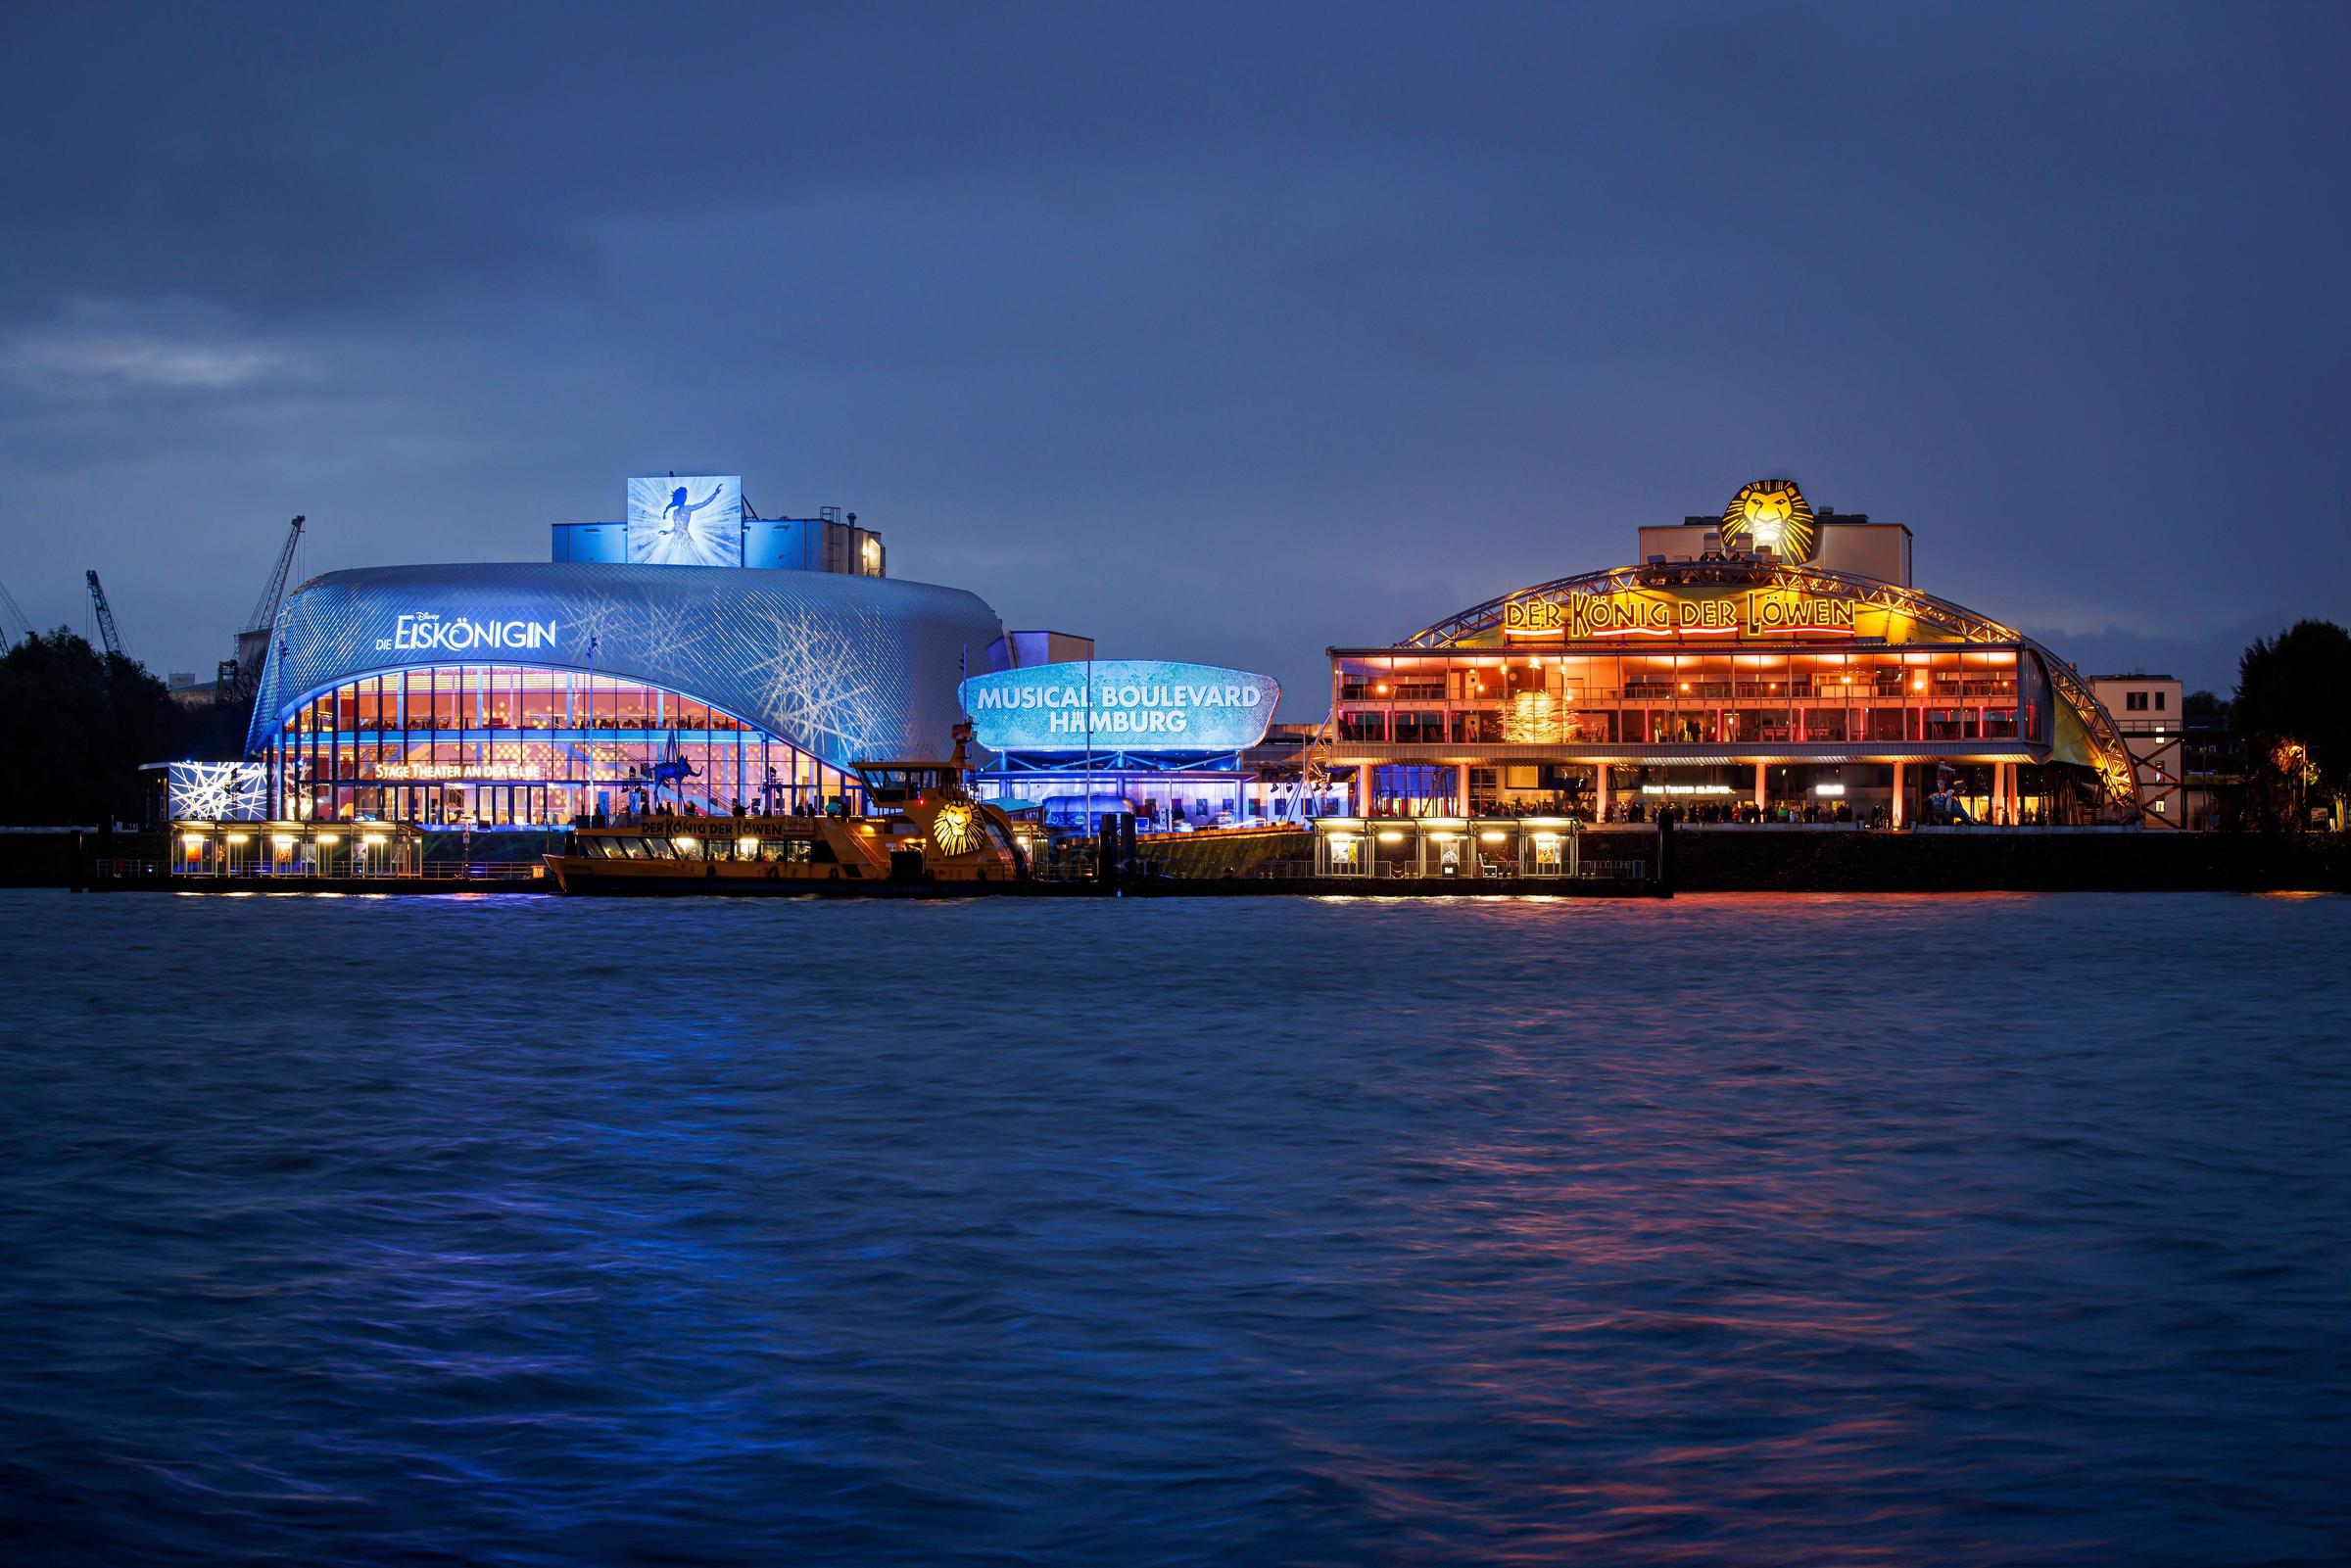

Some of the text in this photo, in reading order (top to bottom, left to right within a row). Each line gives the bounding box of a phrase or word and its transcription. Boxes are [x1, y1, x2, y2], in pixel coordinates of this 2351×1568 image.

[1505, 591, 1855, 637] DER KÖNIG DER LÖWEN
[376, 614, 556, 652] DIE EISKÖNIGIN
[977, 686, 1262, 710] MUSICAL BOULEVARD
[1050, 709, 1188, 734] HAMBURG
[375, 764, 408, 779] STAGE
[412, 764, 461, 779] THEATER
[463, 766, 481, 779] AN
[642, 822, 664, 833] DER
[665, 819, 706, 837] KÖNIG
[709, 822, 733, 834] DER
